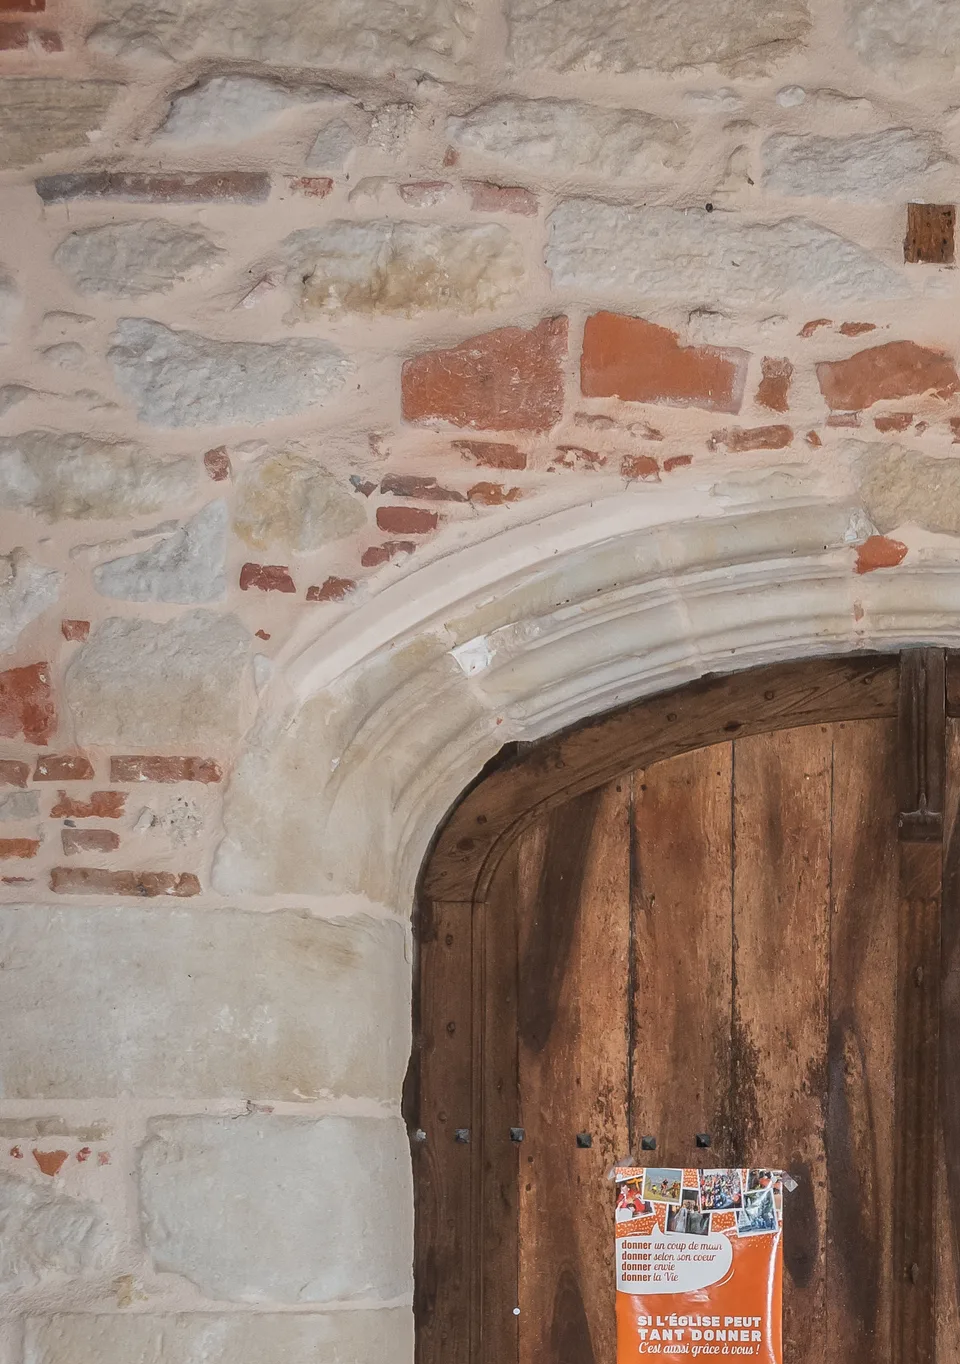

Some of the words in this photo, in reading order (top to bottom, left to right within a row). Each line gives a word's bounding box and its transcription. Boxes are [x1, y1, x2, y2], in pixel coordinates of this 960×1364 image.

[621, 1240, 651, 1250] donner
[667, 1244, 686, 1253] coup
[688, 1242, 698, 1250] de
[621, 1251, 651, 1260] donner
[653, 1252, 674, 1261] selon
[693, 1254, 716, 1262] coeur
[621, 1262, 651, 1271] donner
[654, 1262, 675, 1271] envie
[621, 1272, 651, 1281] donner
[653, 1273, 662, 1281] la
[664, 1273, 679, 1282] Vie
[638, 1315, 652, 1326] SI
[657, 1313, 720, 1327] L'ÉGLISE
[725, 1316, 762, 1327] PEUT
[638, 1329, 685, 1341] TANT
[691, 1329, 762, 1342] DONNER
[638, 1342, 662, 1354] C'est
[663, 1343, 690, 1355] aussi
[691, 1343, 721, 1357] grâce
[722, 1343, 730, 1355] à
[732, 1346, 754, 1355] vous
